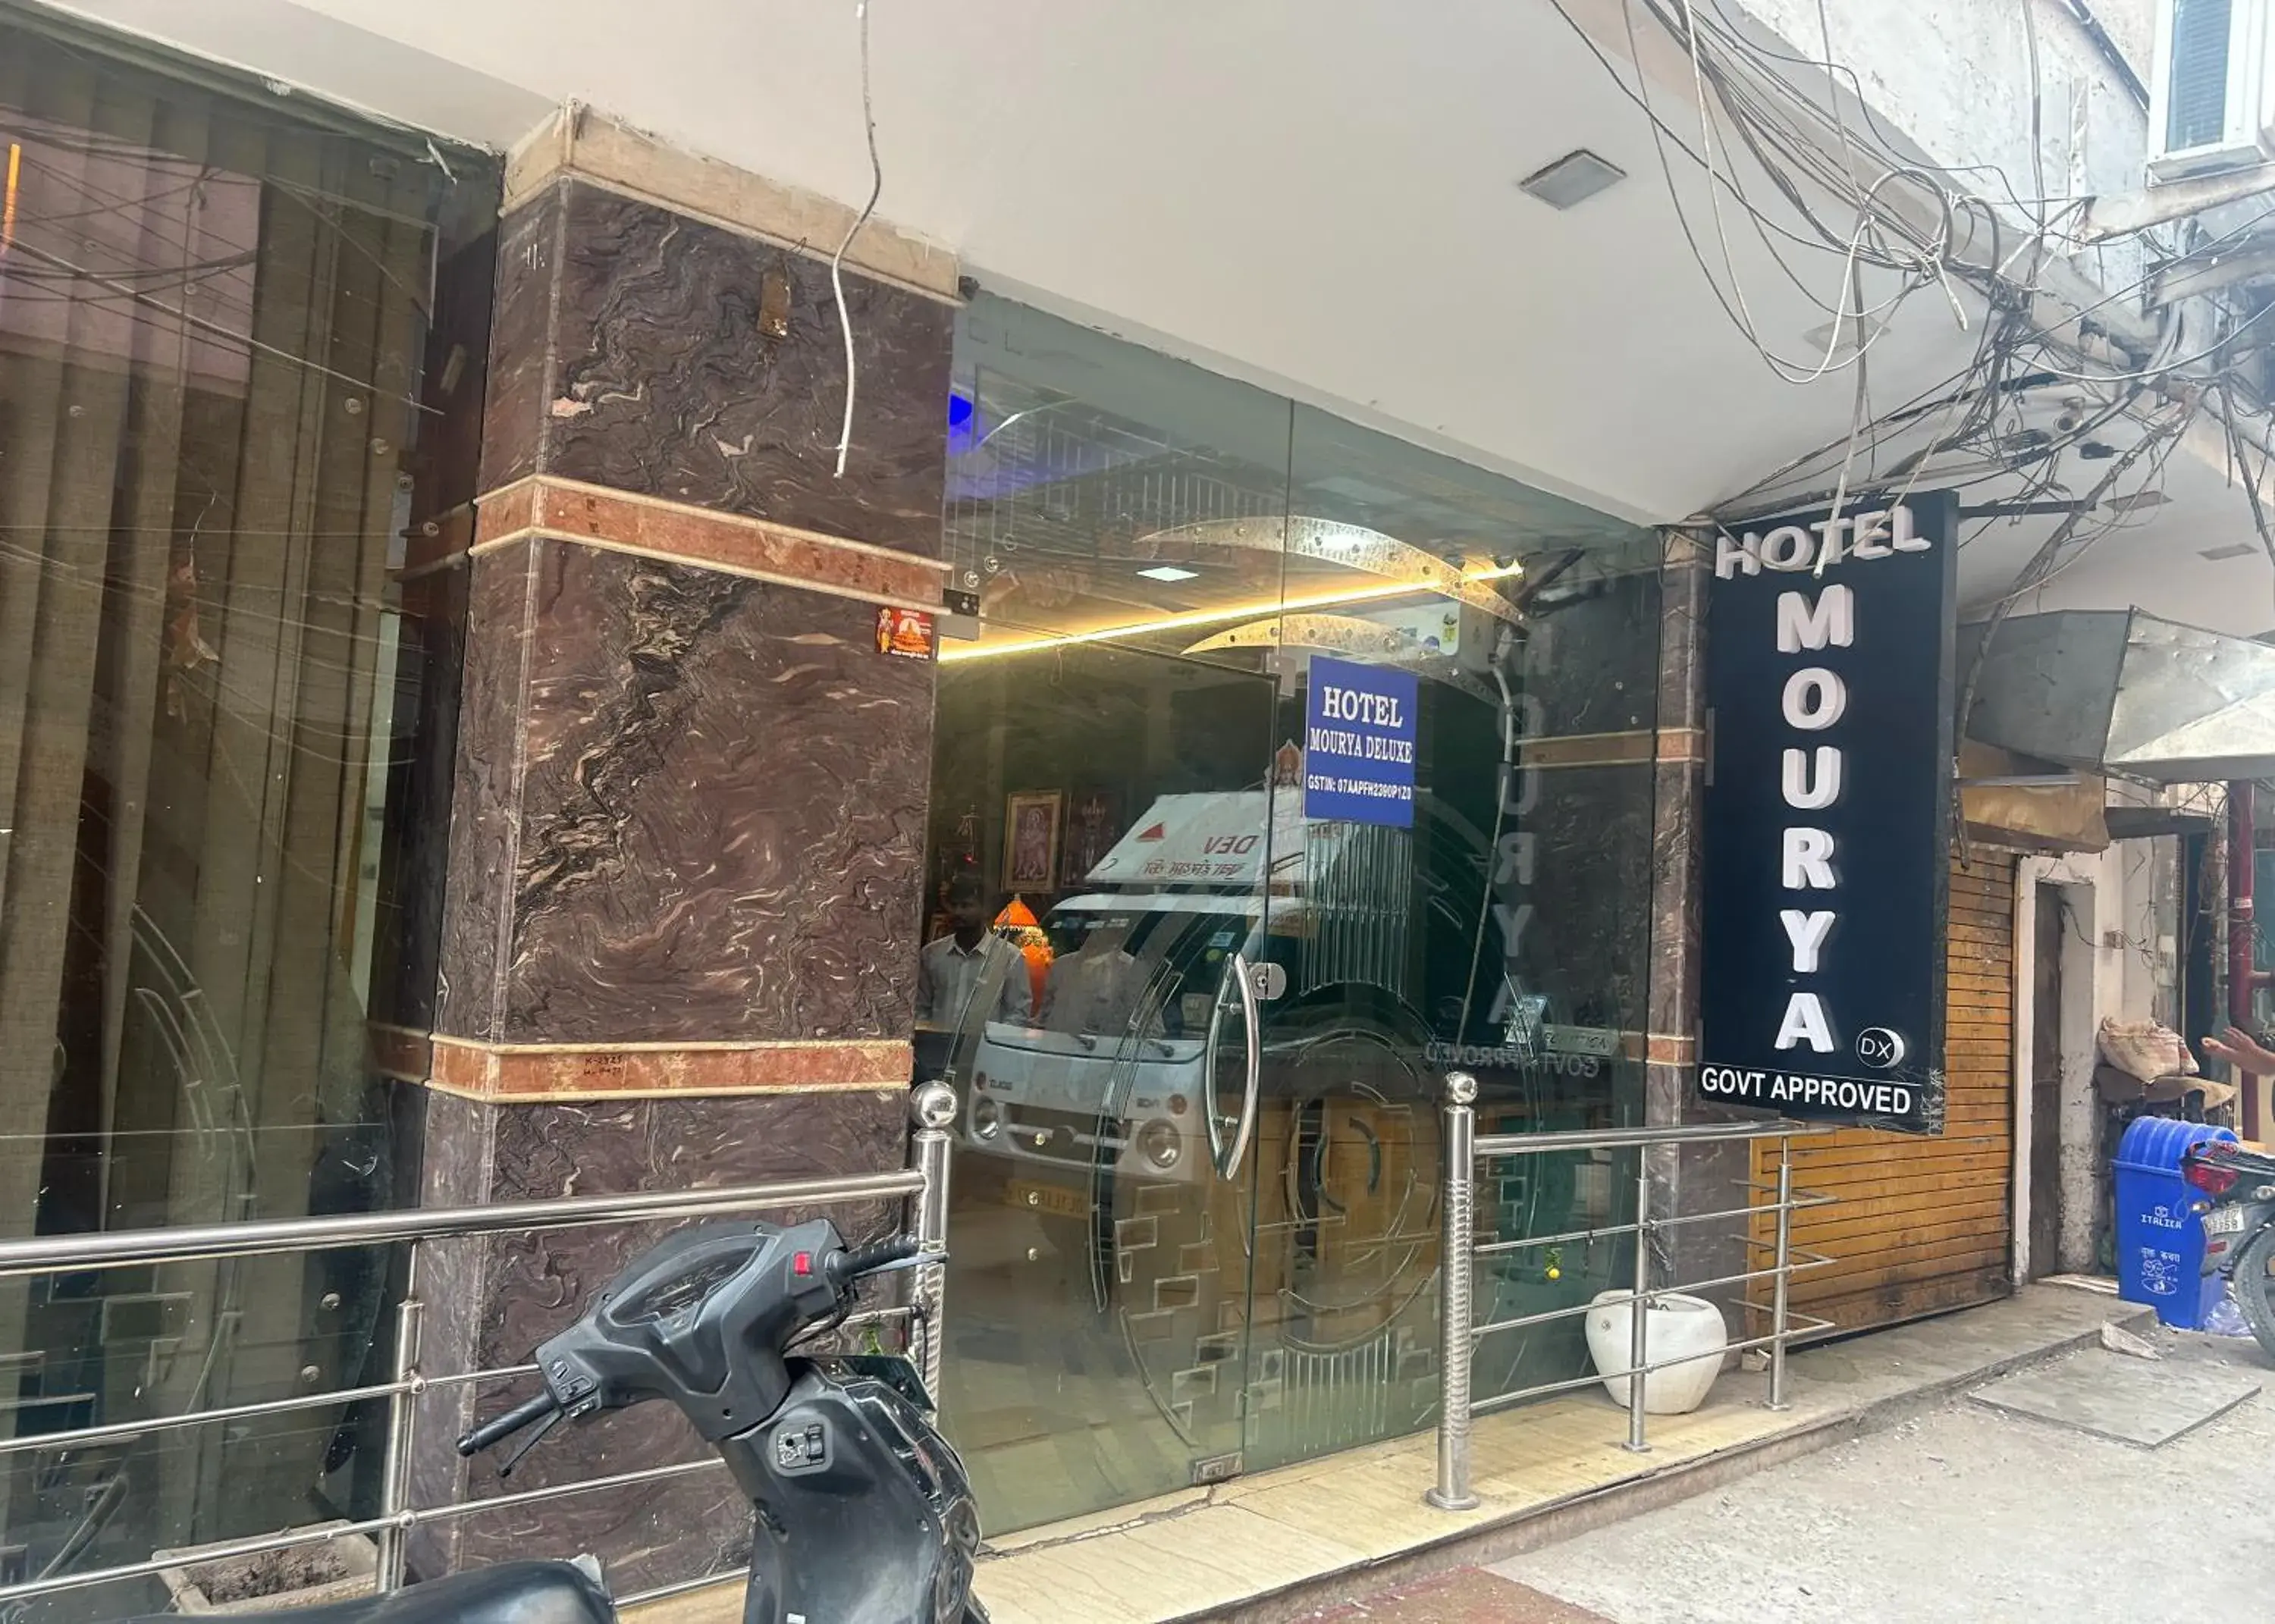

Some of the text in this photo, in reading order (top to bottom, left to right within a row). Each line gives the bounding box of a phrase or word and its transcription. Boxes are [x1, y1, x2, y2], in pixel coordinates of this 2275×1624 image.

[1715, 506, 1931, 579] HOTEL
[1322, 685, 1403, 728] HOTEL
[1310, 728, 1413, 763] MOURYA DELUXE
[1774, 583, 1854, 1053] MOURYA
[1860, 1037, 1892, 1060] DX
[1702, 1068, 1911, 1115] GOVT APPROVED
